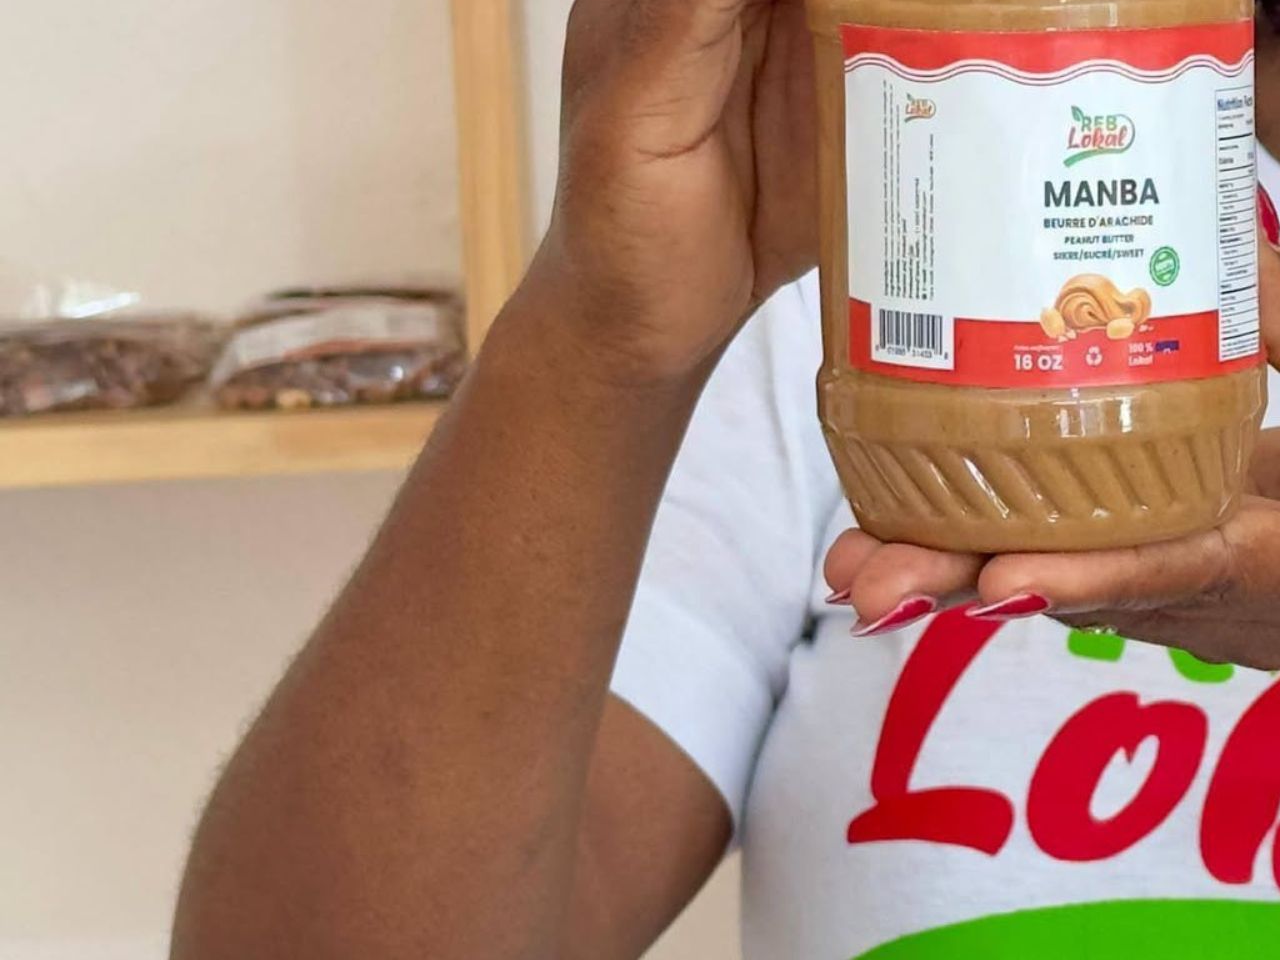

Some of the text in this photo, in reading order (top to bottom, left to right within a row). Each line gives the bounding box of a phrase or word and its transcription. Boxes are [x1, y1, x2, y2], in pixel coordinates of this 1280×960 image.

[1067, 125, 1128, 150] Lokal
[1043, 177, 1160, 208] MANBA
[1043, 217, 1086, 229] BEURRE
[1064, 233, 1135, 246] PEANUT BUTTER
[1013, 353, 1064, 371] 16 OZ
